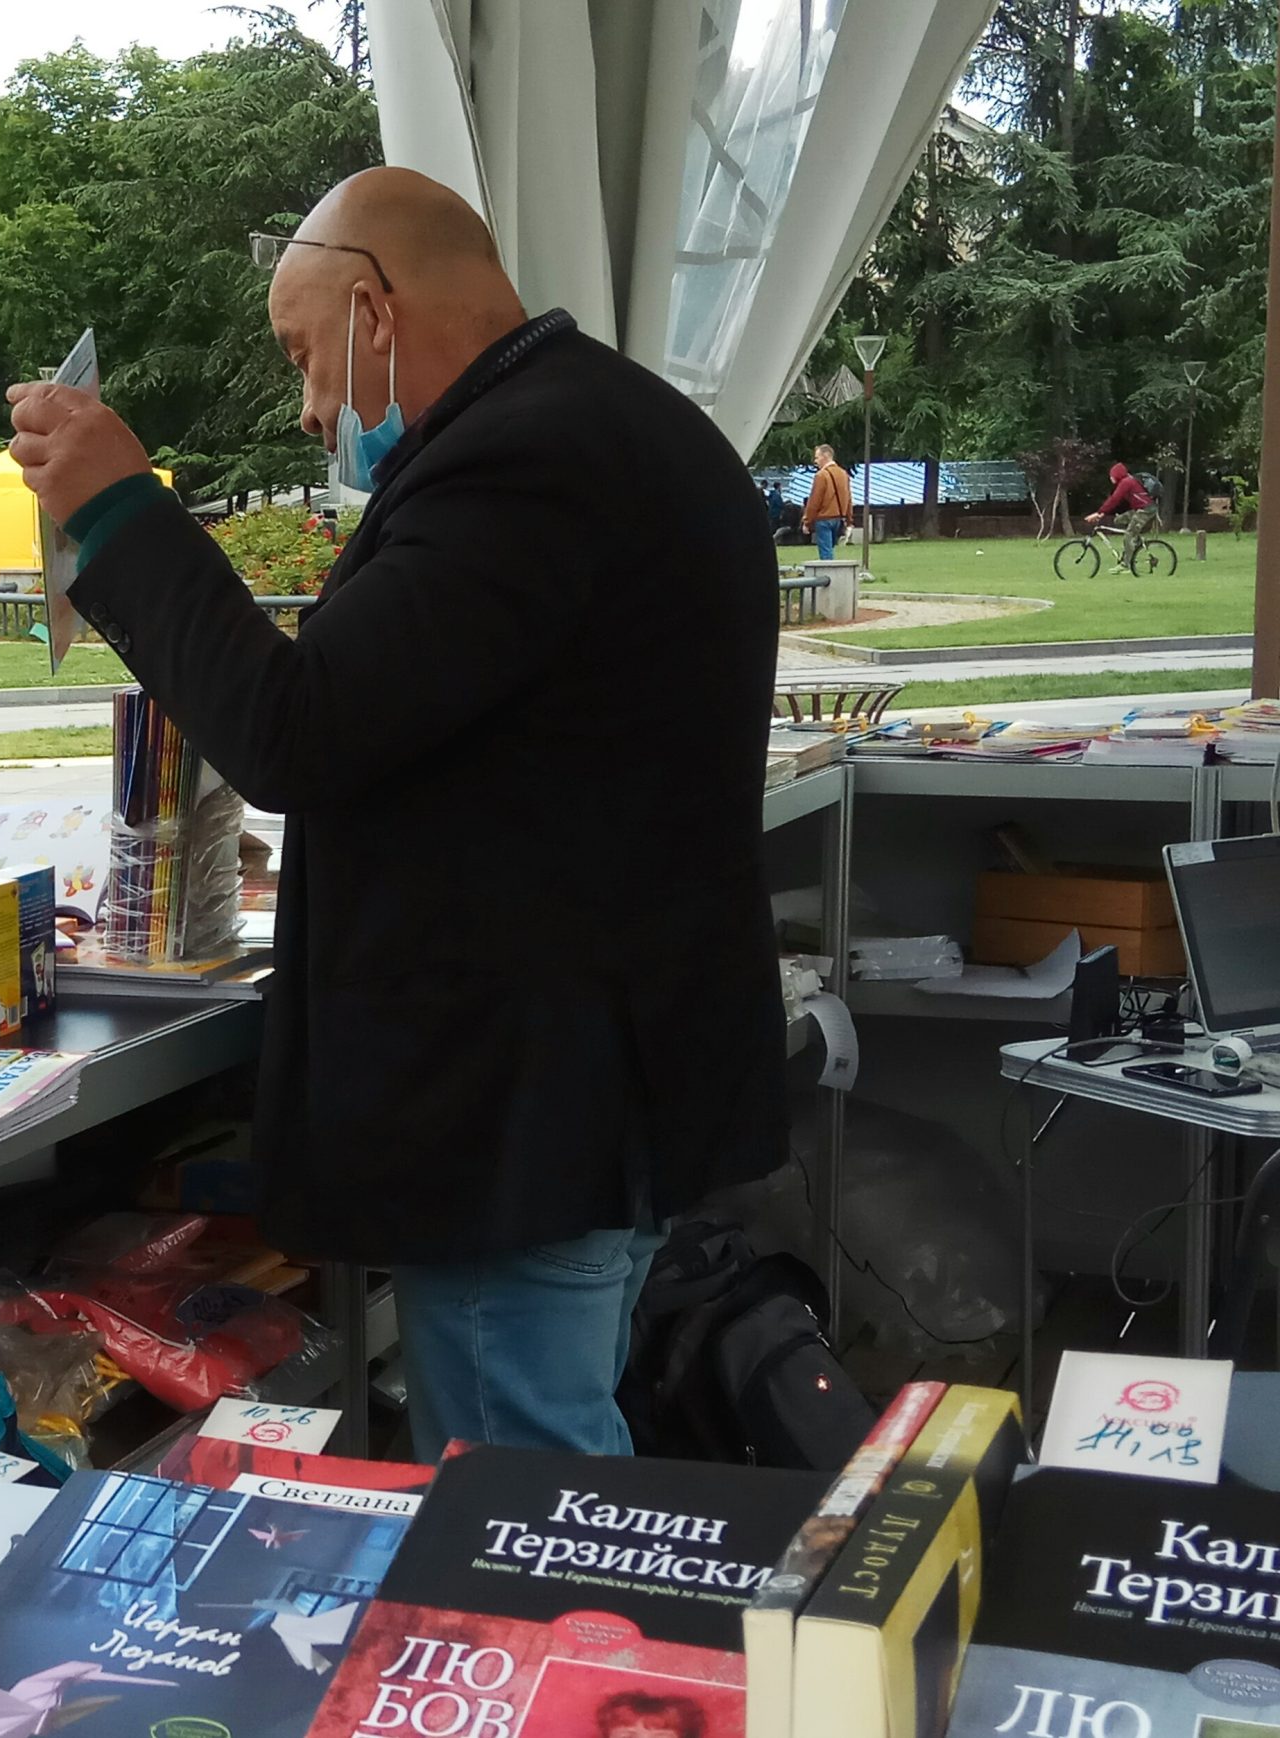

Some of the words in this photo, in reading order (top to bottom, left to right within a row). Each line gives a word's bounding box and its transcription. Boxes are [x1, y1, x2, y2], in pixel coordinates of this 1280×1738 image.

[258, 1479, 413, 1515] Светлана
[548, 1488, 728, 1545] Калин
[484, 1518, 775, 1591] Терзийски
[1154, 1519, 1280, 1574] Кал
[1081, 1552, 1280, 1624] Терзи
[121, 1601, 244, 1648] Йордан
[89, 1628, 242, 1678] Лозанов
[380, 1635, 515, 1691] ЛЮ
[359, 1682, 515, 1738] БОВ
[995, 1684, 1152, 1738] ЛЮ
